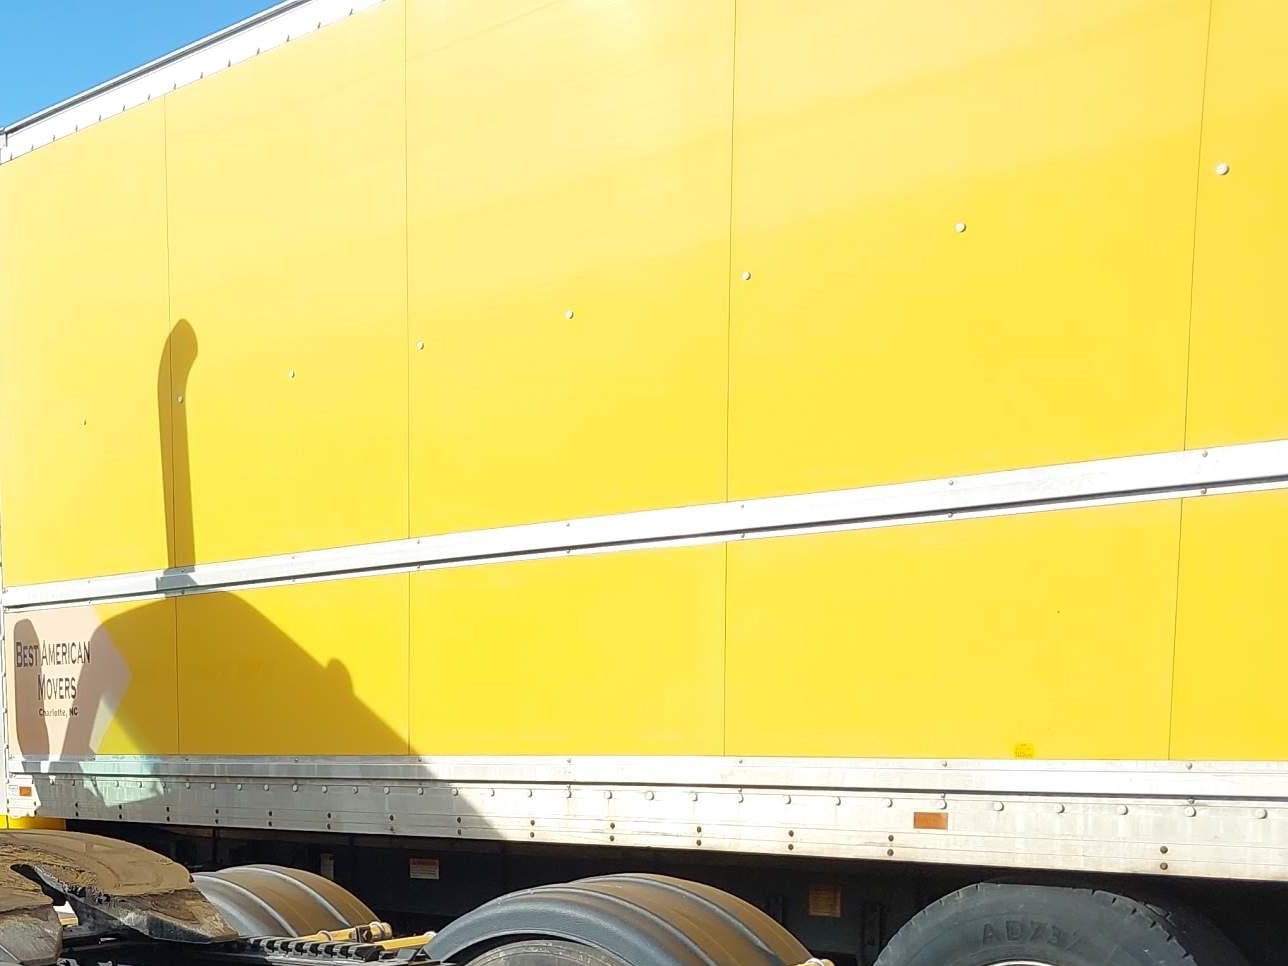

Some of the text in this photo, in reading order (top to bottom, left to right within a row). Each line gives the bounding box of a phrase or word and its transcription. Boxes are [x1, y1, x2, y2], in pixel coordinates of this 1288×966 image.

[16, 640, 91, 668] BEST AMERICAN
[38, 674, 77, 701] MOVERS
[69, 706, 78, 716] NC
